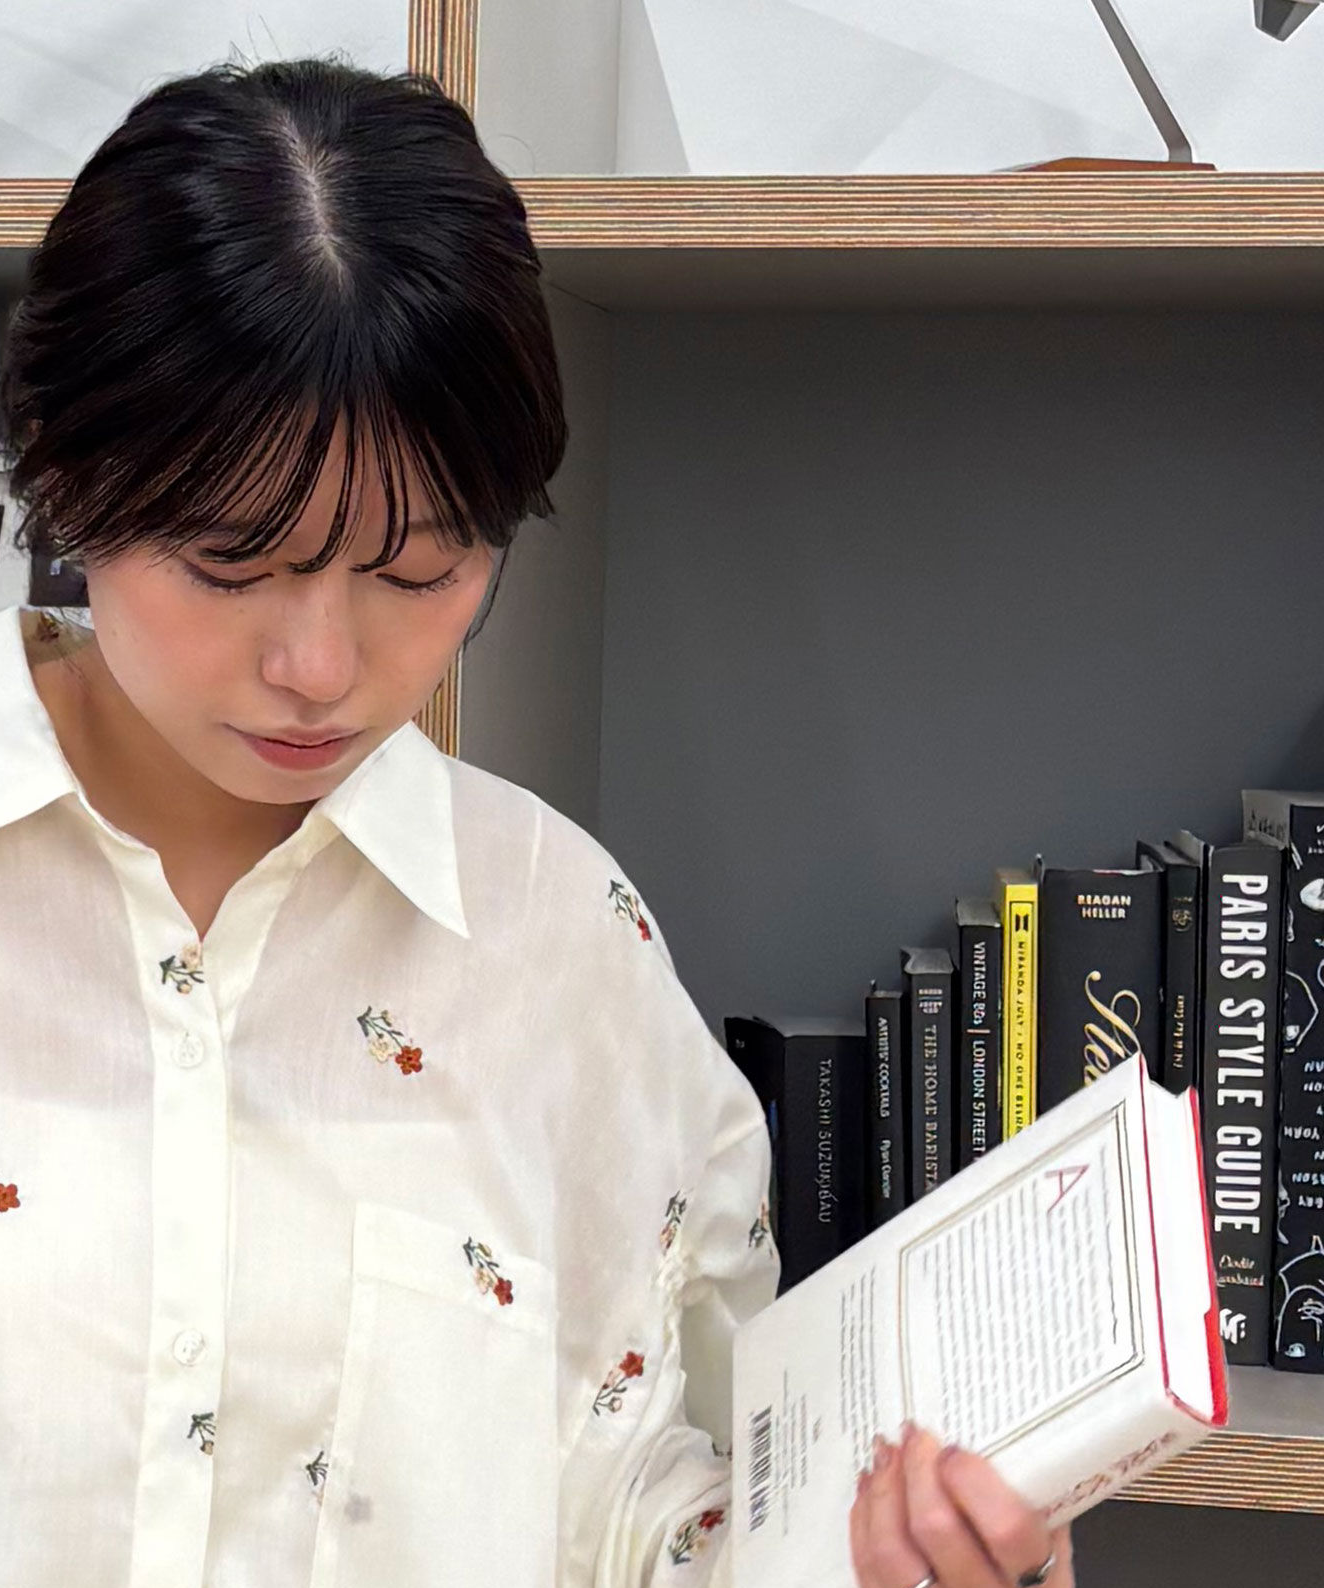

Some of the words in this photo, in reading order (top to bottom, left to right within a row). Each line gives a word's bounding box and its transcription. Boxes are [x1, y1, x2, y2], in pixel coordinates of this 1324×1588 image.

[1081, 907, 1126, 919] HELLER
[1220, 873, 1269, 980] PARIS
[973, 941, 986, 999] VINTAGE
[1017, 941, 1026, 995] MIRANDA
[924, 1024, 938, 1059] THE
[973, 1040, 986, 1098] LONDON
[1216, 999, 1265, 1108] STYLE
[818, 1058, 833, 1126] TAKASHI
[924, 1063, 939, 1116] HOME
[973, 1102, 986, 1153] STREET
[1214, 1125, 1263, 1234] GUIDE
